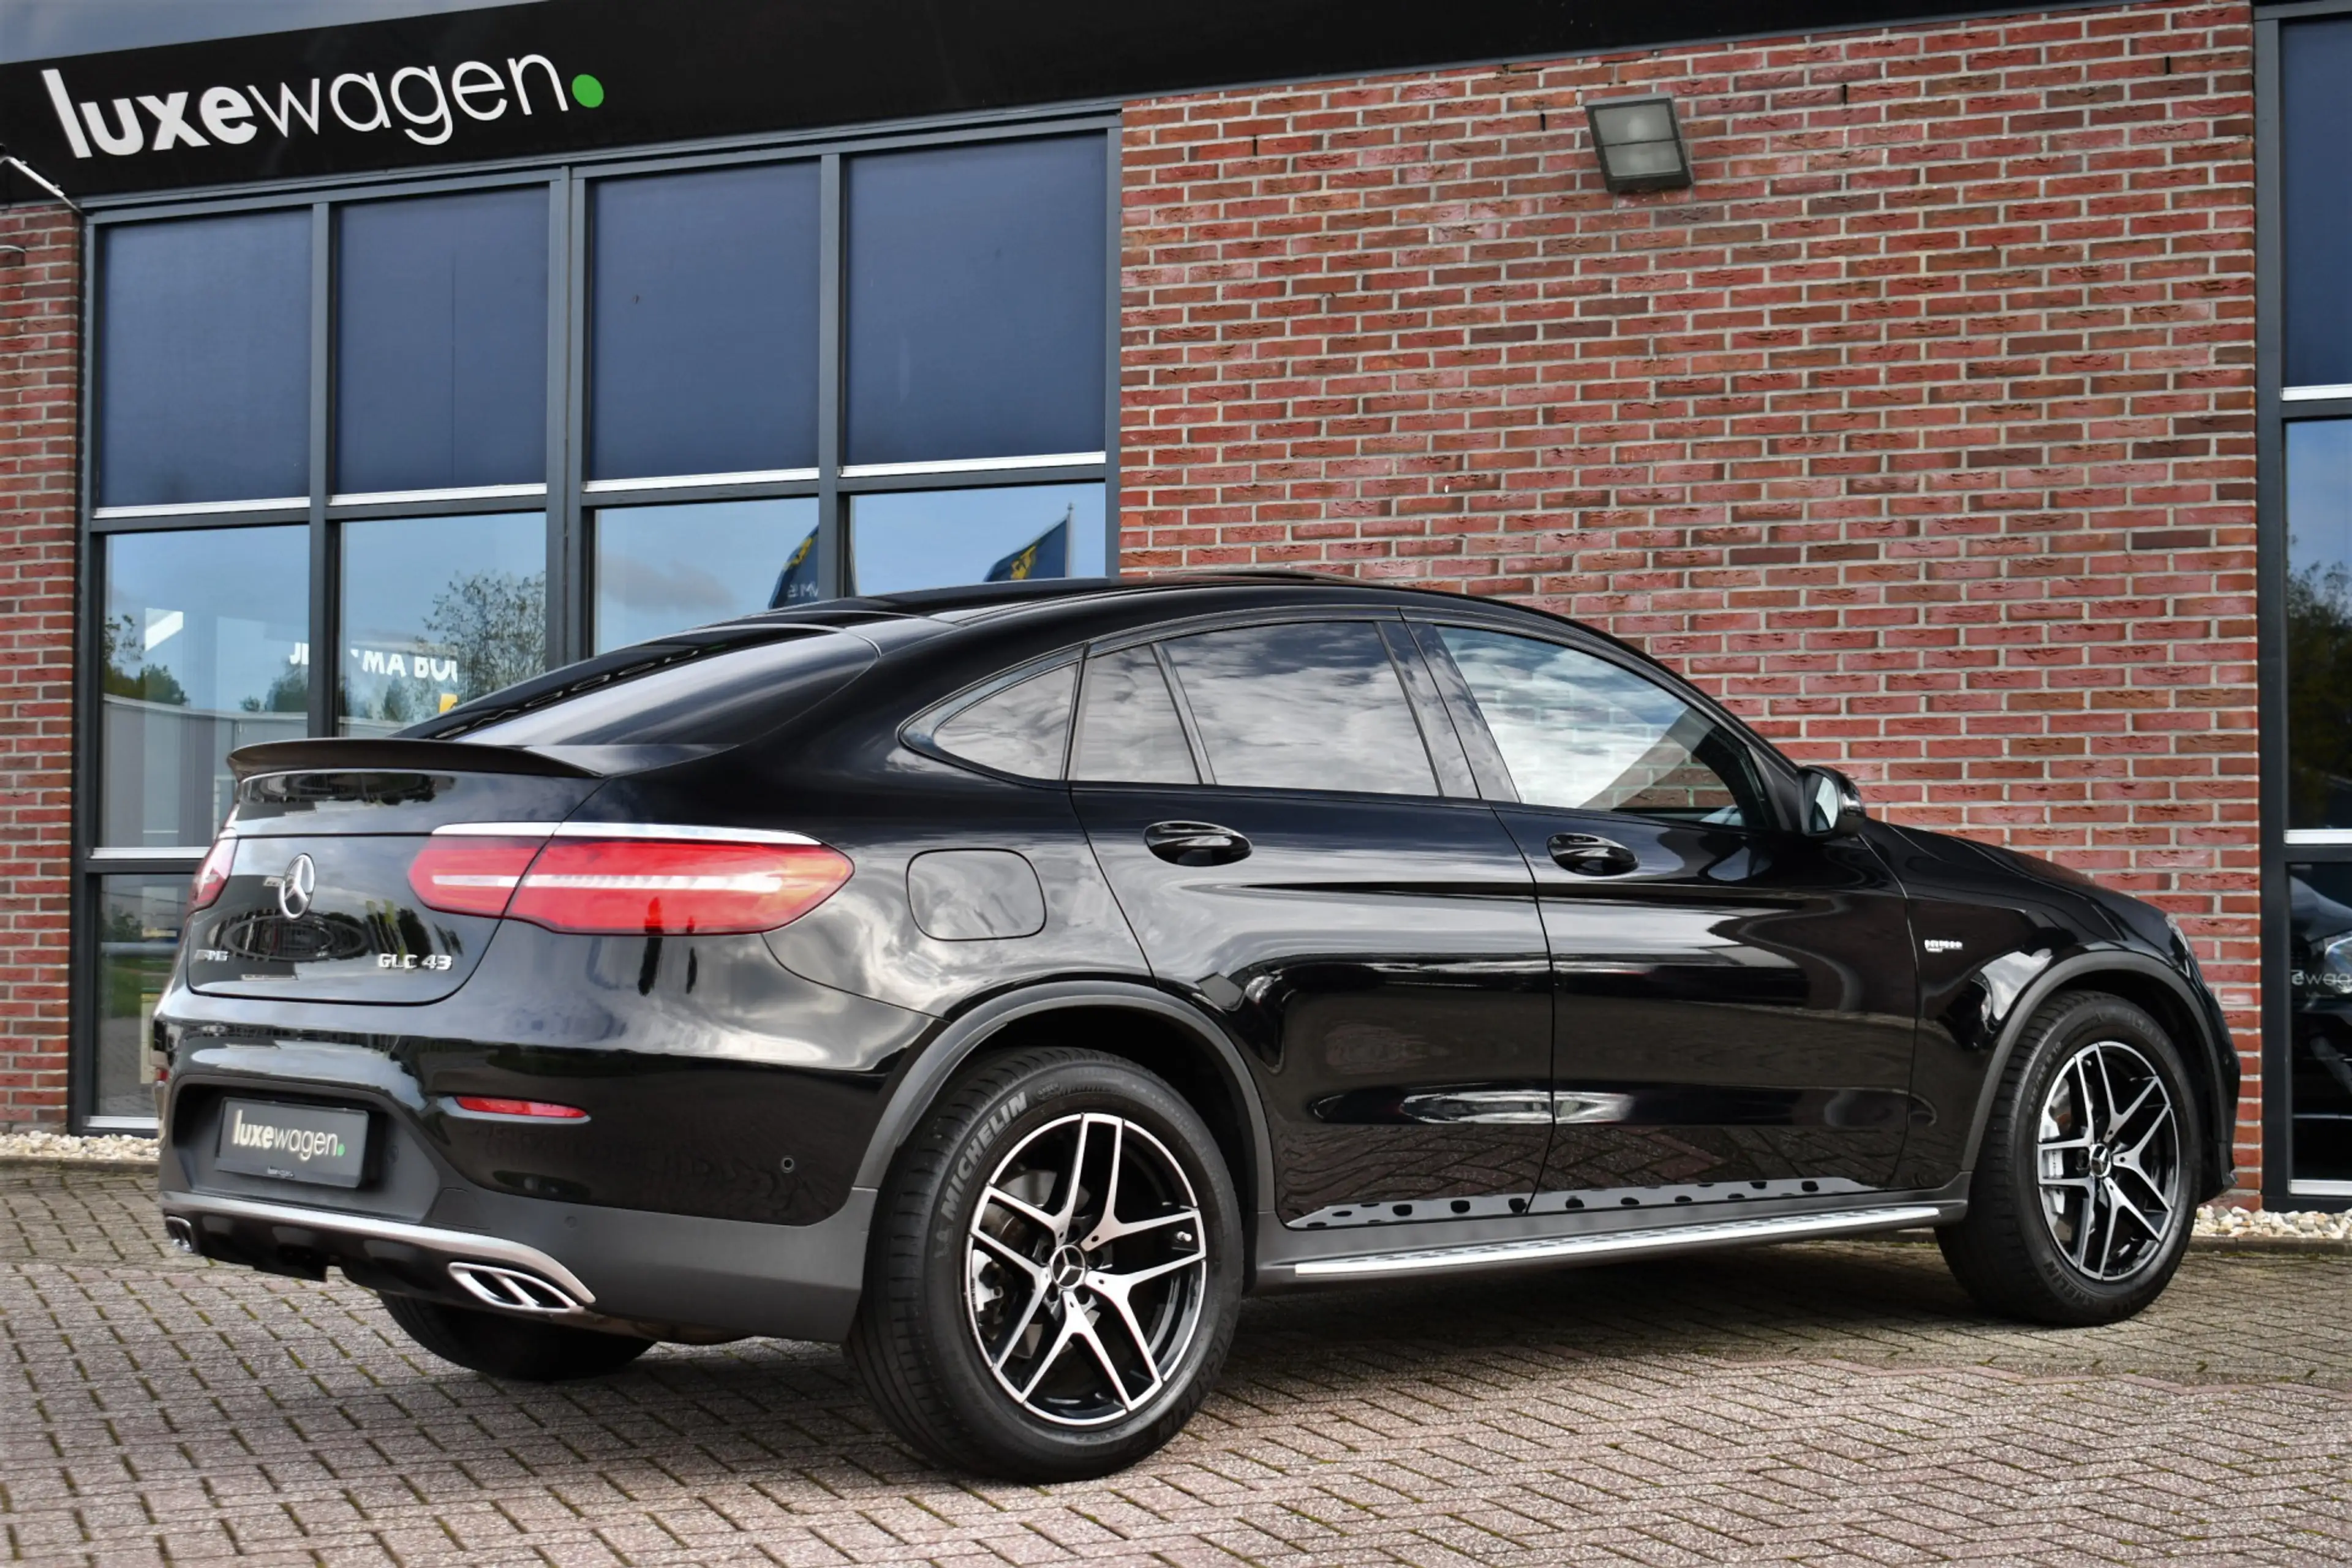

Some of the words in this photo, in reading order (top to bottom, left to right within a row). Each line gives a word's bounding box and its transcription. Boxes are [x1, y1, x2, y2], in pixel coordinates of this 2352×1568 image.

[378, 953, 418, 968] GLC
[421, 954, 452, 970] 43
[941, 1091, 1028, 1221] MICHELIN
